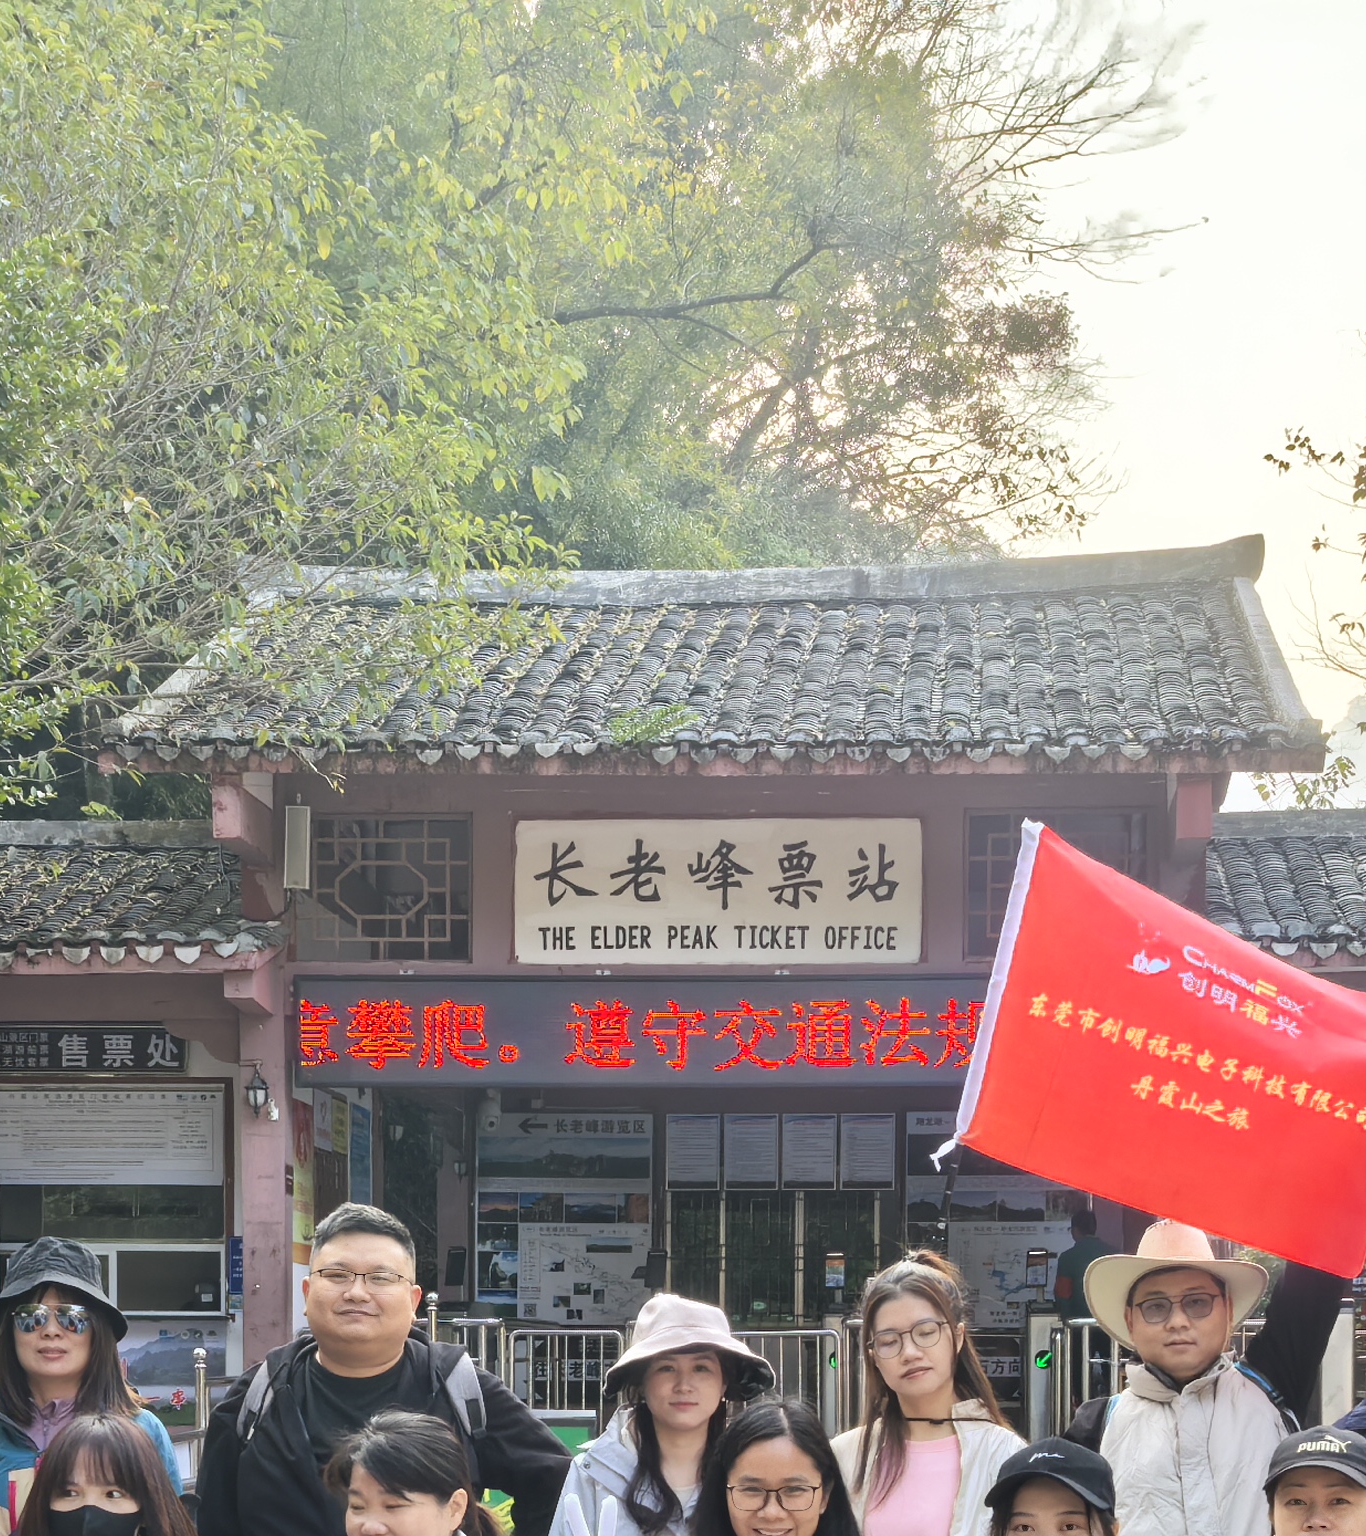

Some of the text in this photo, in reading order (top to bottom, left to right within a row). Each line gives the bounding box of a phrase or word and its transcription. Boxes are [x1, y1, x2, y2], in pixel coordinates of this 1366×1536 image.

[533, 838, 900, 911] 长老峰票站
[537, 925, 899, 951] THE ELDER PEAK TICKET OFFICE
[1178, 971, 1303, 1039] 创明福兴
[57, 1033, 180, 1068] 售票处
[1130, 1074, 1251, 1131] 丹霞山之旅
[554, 1119, 646, 1134] 长老峰游览区
[1297, 1441, 1340, 1453] PUMA
